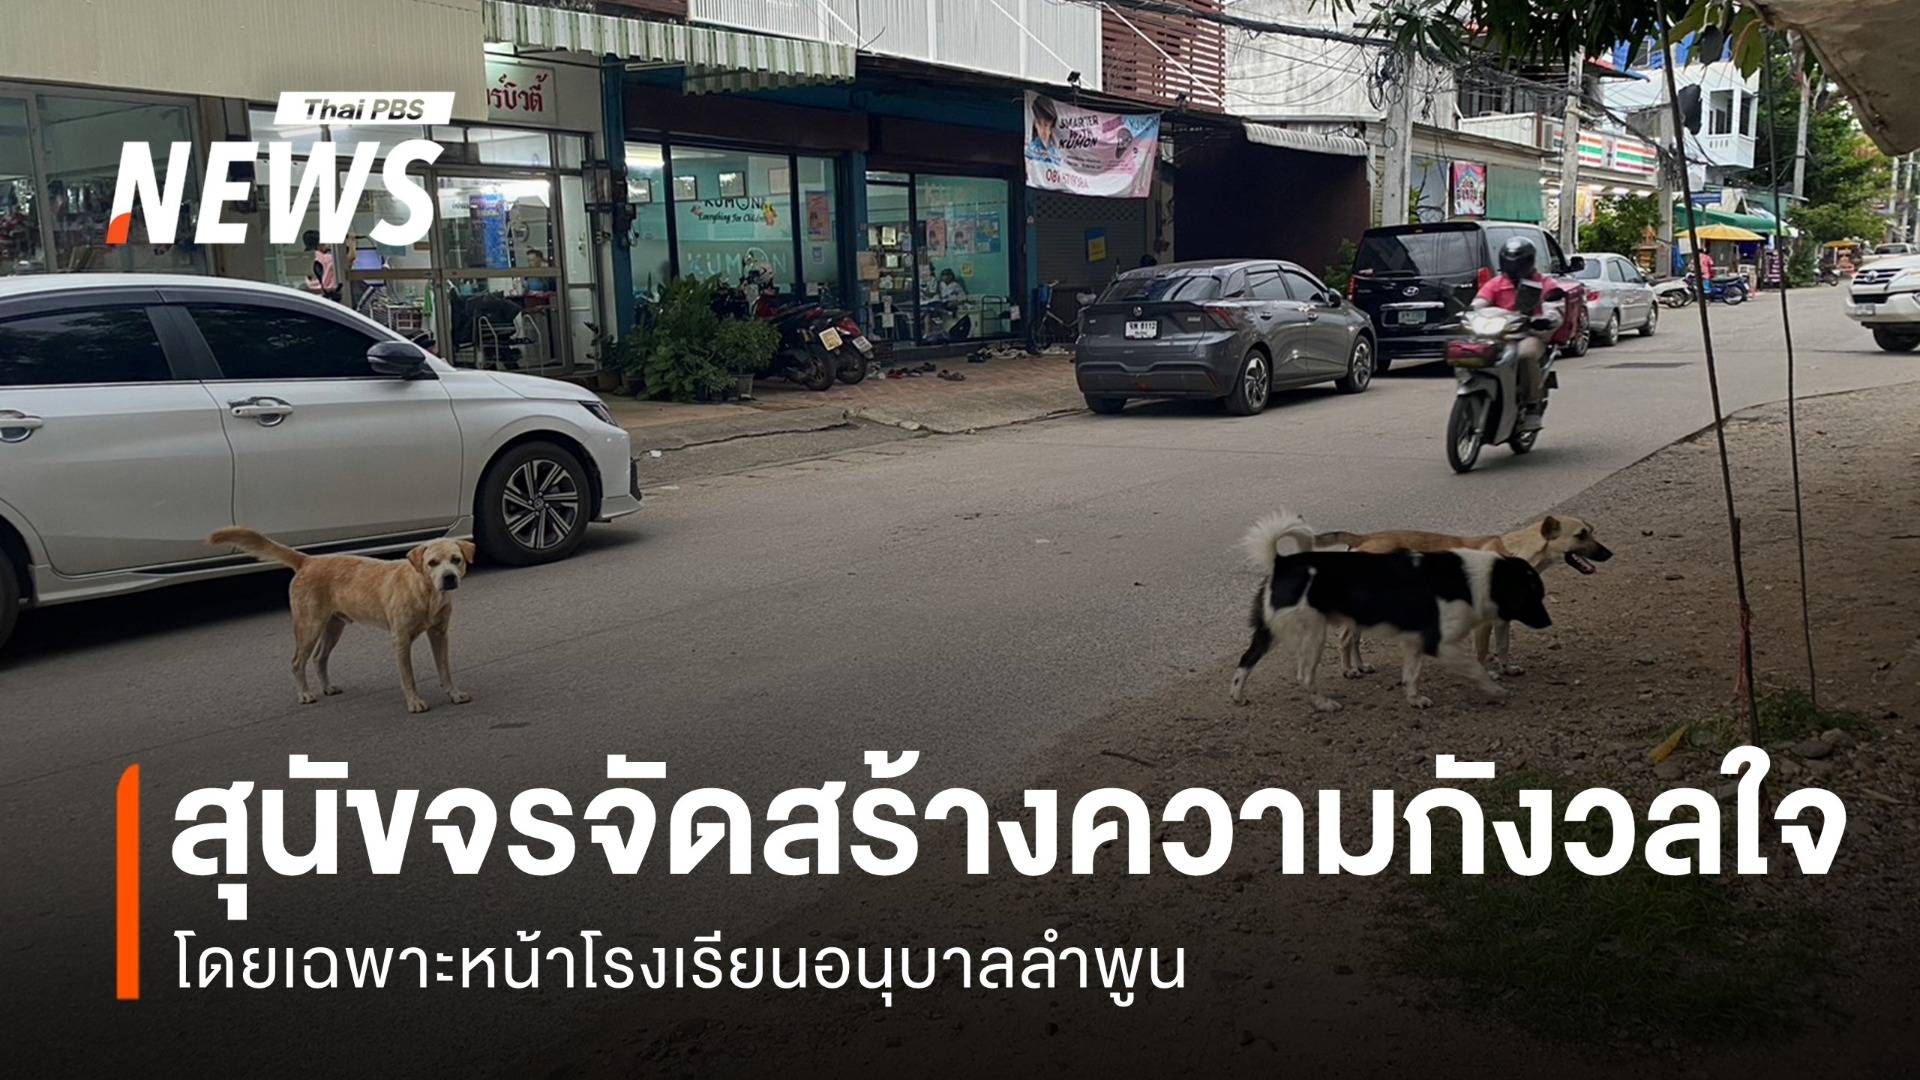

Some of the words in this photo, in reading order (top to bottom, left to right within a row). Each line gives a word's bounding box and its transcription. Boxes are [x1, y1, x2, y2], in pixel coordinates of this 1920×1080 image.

[1059, 114, 1099, 129] SMARTER
[1059, 137, 1098, 149] KUMON
[704, 198, 760, 210] KUMON
